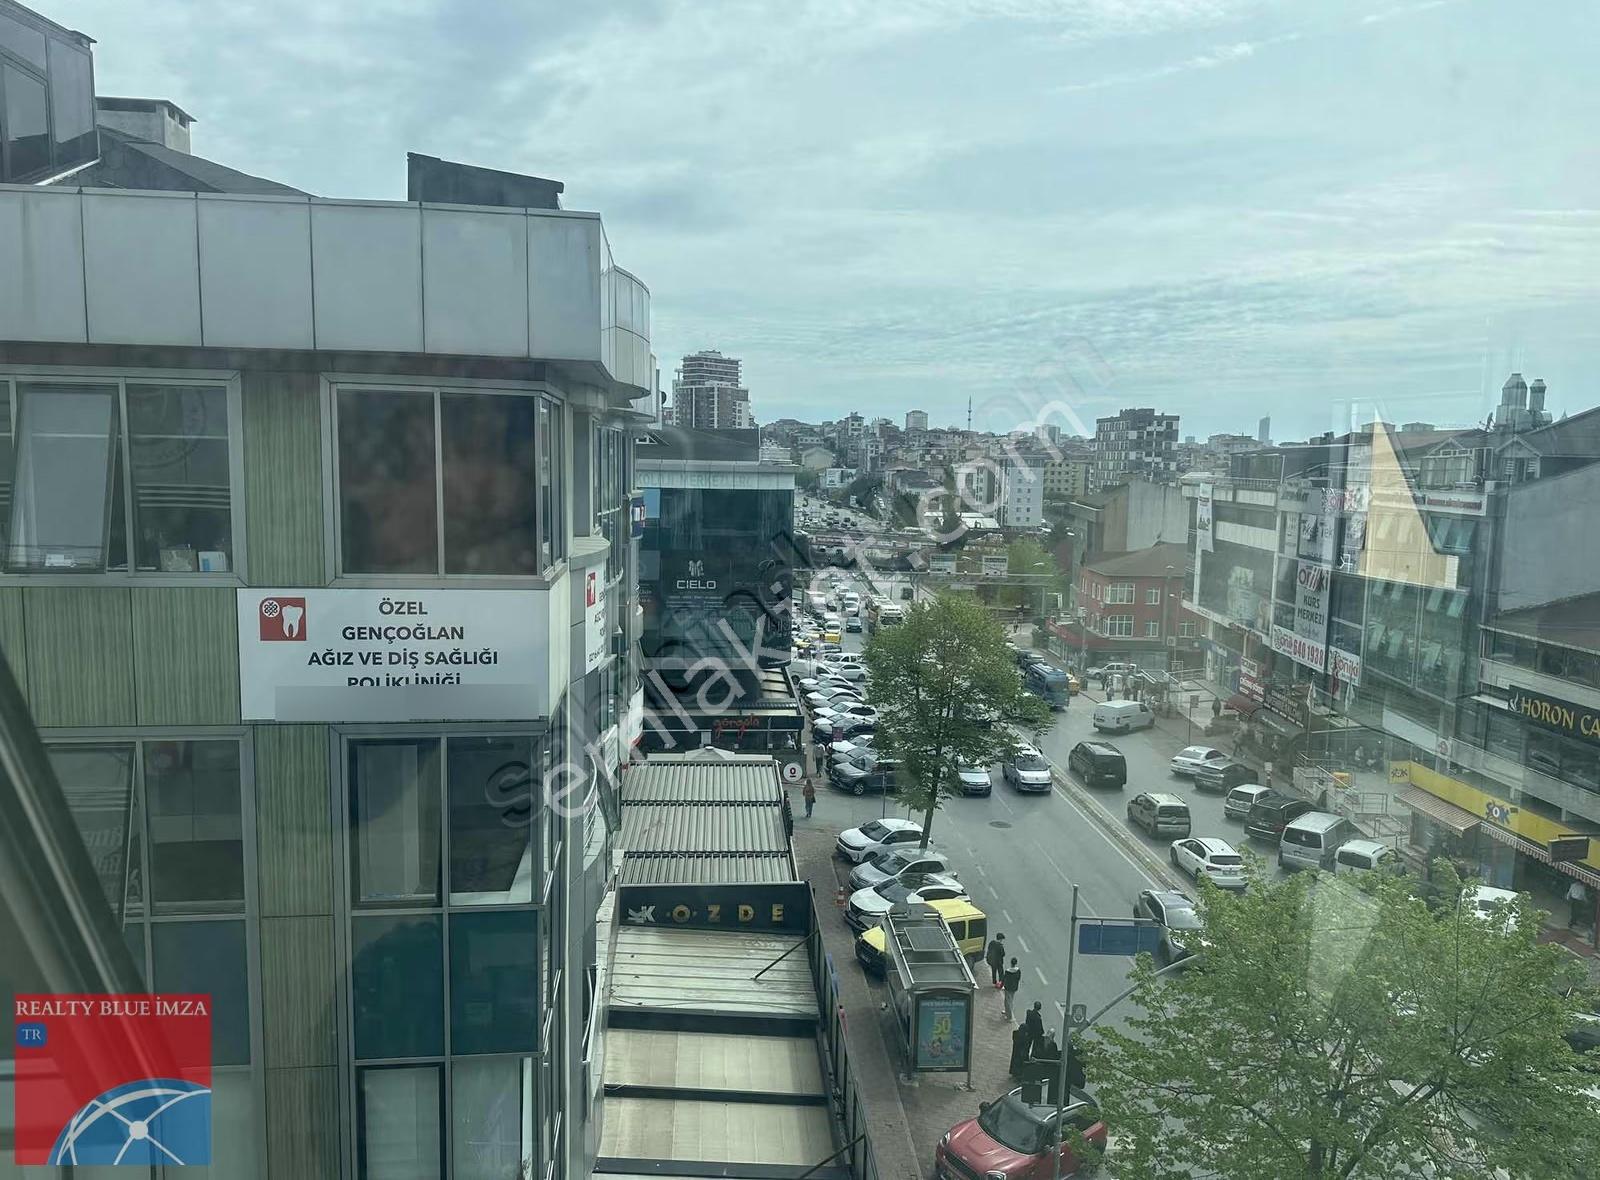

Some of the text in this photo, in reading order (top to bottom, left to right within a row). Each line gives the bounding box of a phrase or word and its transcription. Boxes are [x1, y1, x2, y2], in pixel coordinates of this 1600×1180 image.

[676, 579, 717, 590] CIELO
[379, 597, 428, 615] ÖZEL
[342, 623, 464, 645] GENÇOĞLAN
[308, 648, 498, 670] AĞIZ VE DİŞ SAĞLIĞI
[1521, 696, 1575, 730] HORON
